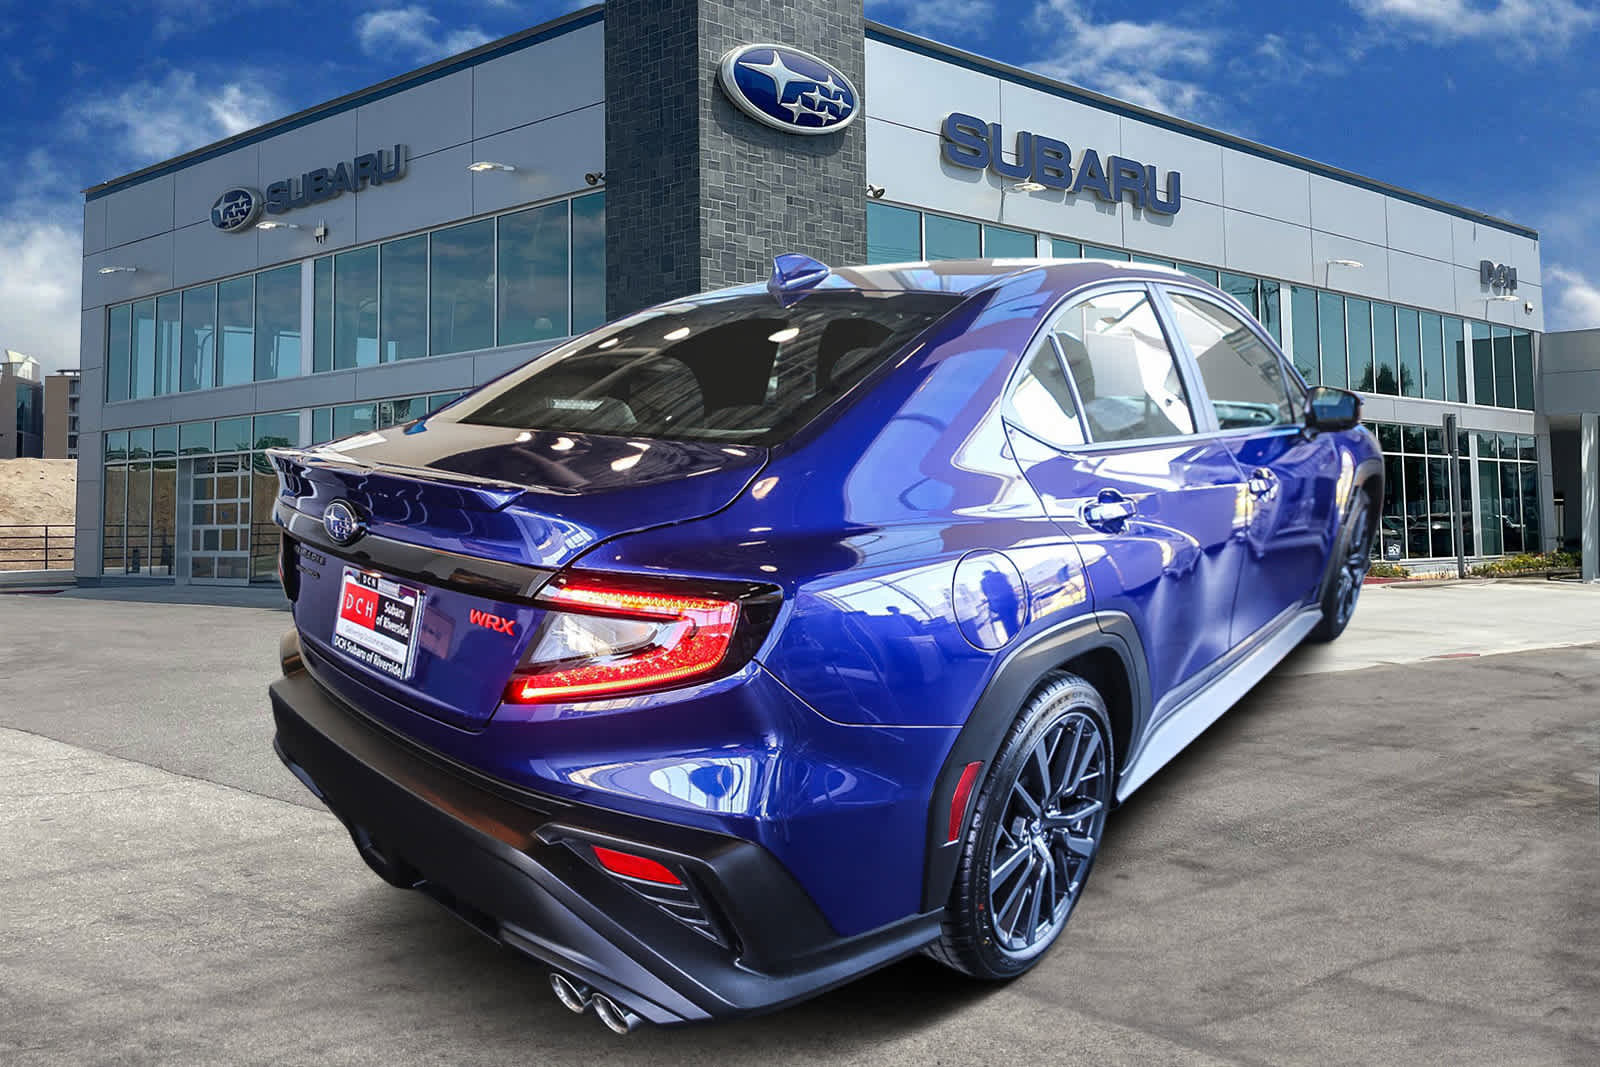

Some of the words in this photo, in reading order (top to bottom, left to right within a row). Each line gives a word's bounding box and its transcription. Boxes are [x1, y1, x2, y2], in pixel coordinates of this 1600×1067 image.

[941, 112, 1181, 215] SUBARU
[265, 143, 407, 214] SUBARU
[345, 593, 374, 618] DCH
[384, 601, 406, 620] Subaru
[376, 615, 384, 626] of
[383, 617, 409, 637] Riverside
[470, 608, 515, 636] WRX
[335, 635, 347, 650] DCH
[346, 642, 366, 660] Subaru
[366, 652, 375, 663] of
[373, 655, 403, 678] Riverside
